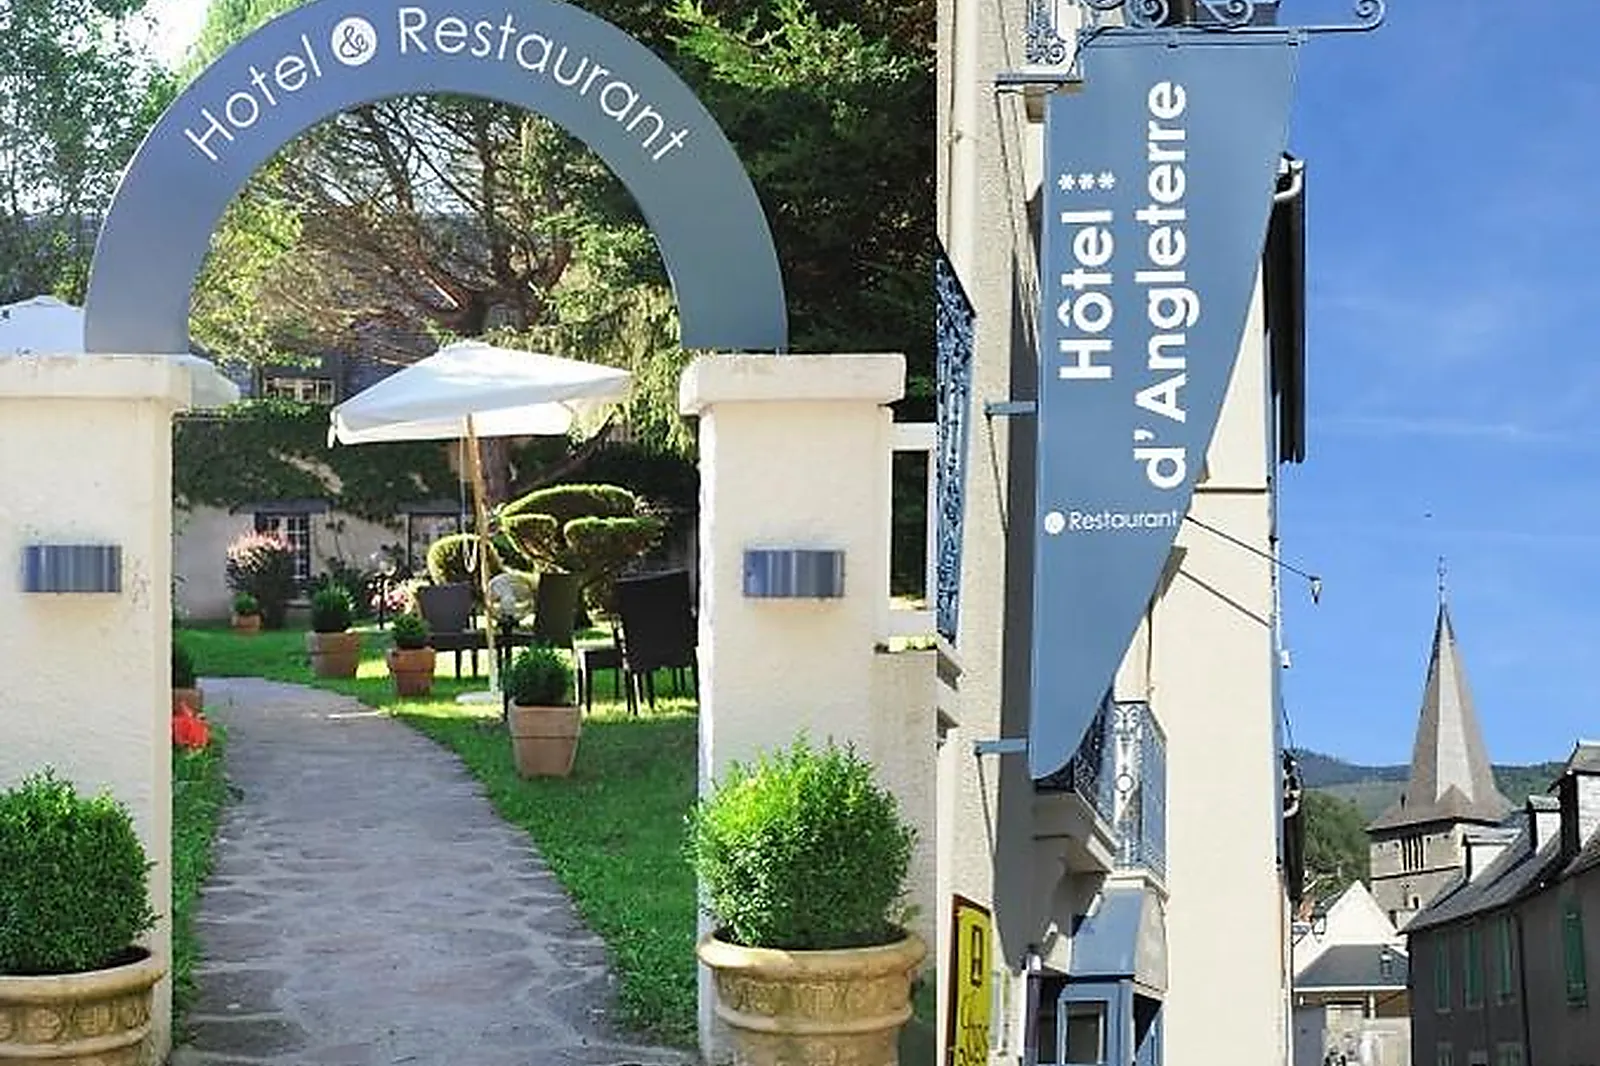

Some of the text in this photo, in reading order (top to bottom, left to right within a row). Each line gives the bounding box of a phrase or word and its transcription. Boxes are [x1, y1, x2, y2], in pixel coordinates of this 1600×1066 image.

[184, 35, 321, 161] Hotel
[399, 7, 690, 161] Restaurant
[1058, 209, 1114, 380] Hôtel
[1069, 510, 1178, 531] Restaurant
